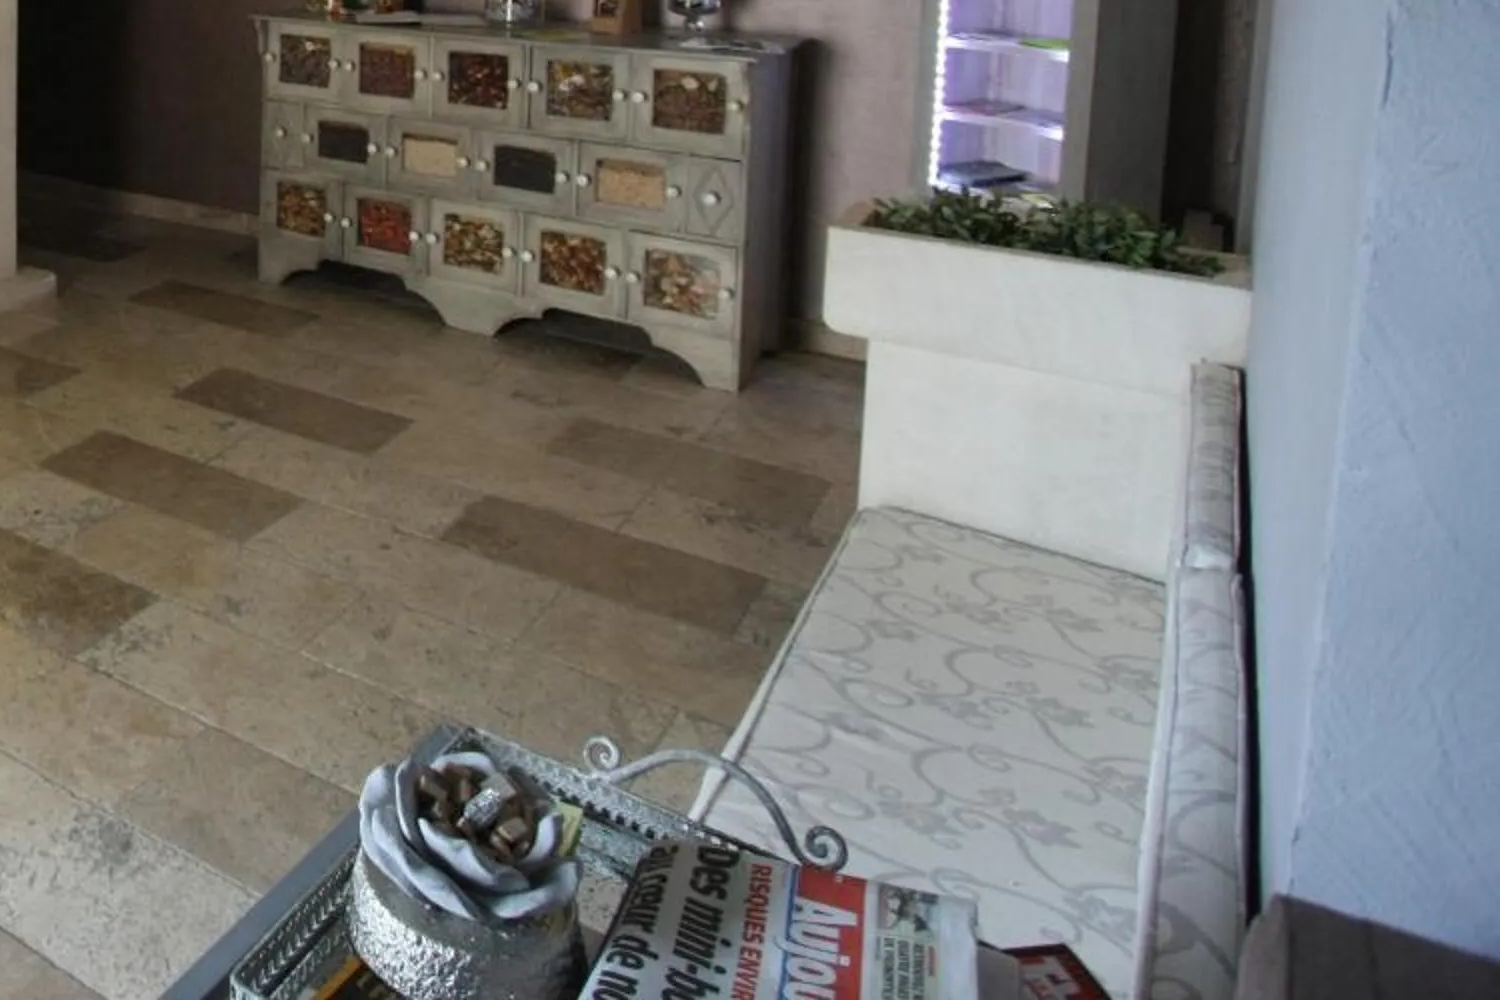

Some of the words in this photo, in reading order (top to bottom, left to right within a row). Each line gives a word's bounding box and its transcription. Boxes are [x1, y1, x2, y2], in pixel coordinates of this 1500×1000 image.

[688, 845, 740, 901] Des
[742, 863, 772, 944] RISQUES
[605, 934, 659, 971] de
